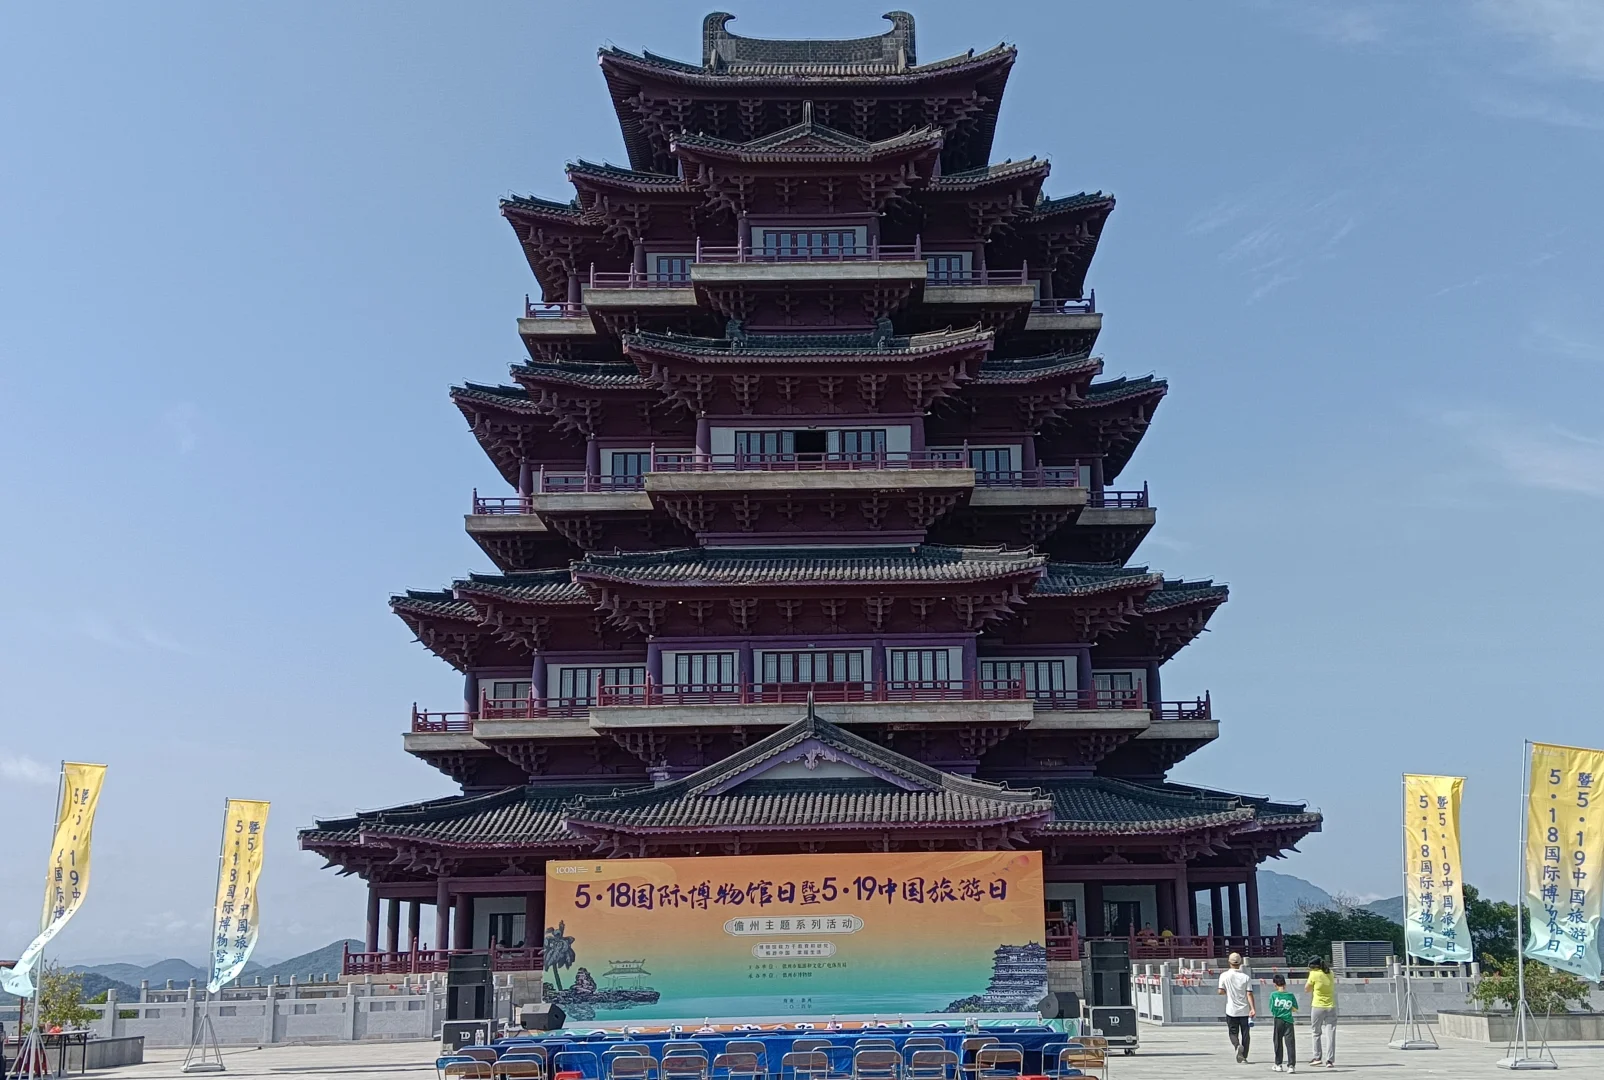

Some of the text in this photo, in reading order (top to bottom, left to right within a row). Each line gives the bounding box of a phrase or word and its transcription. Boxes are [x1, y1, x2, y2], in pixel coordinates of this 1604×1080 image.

[733, 918, 853, 932] 儋州主题系列活动
